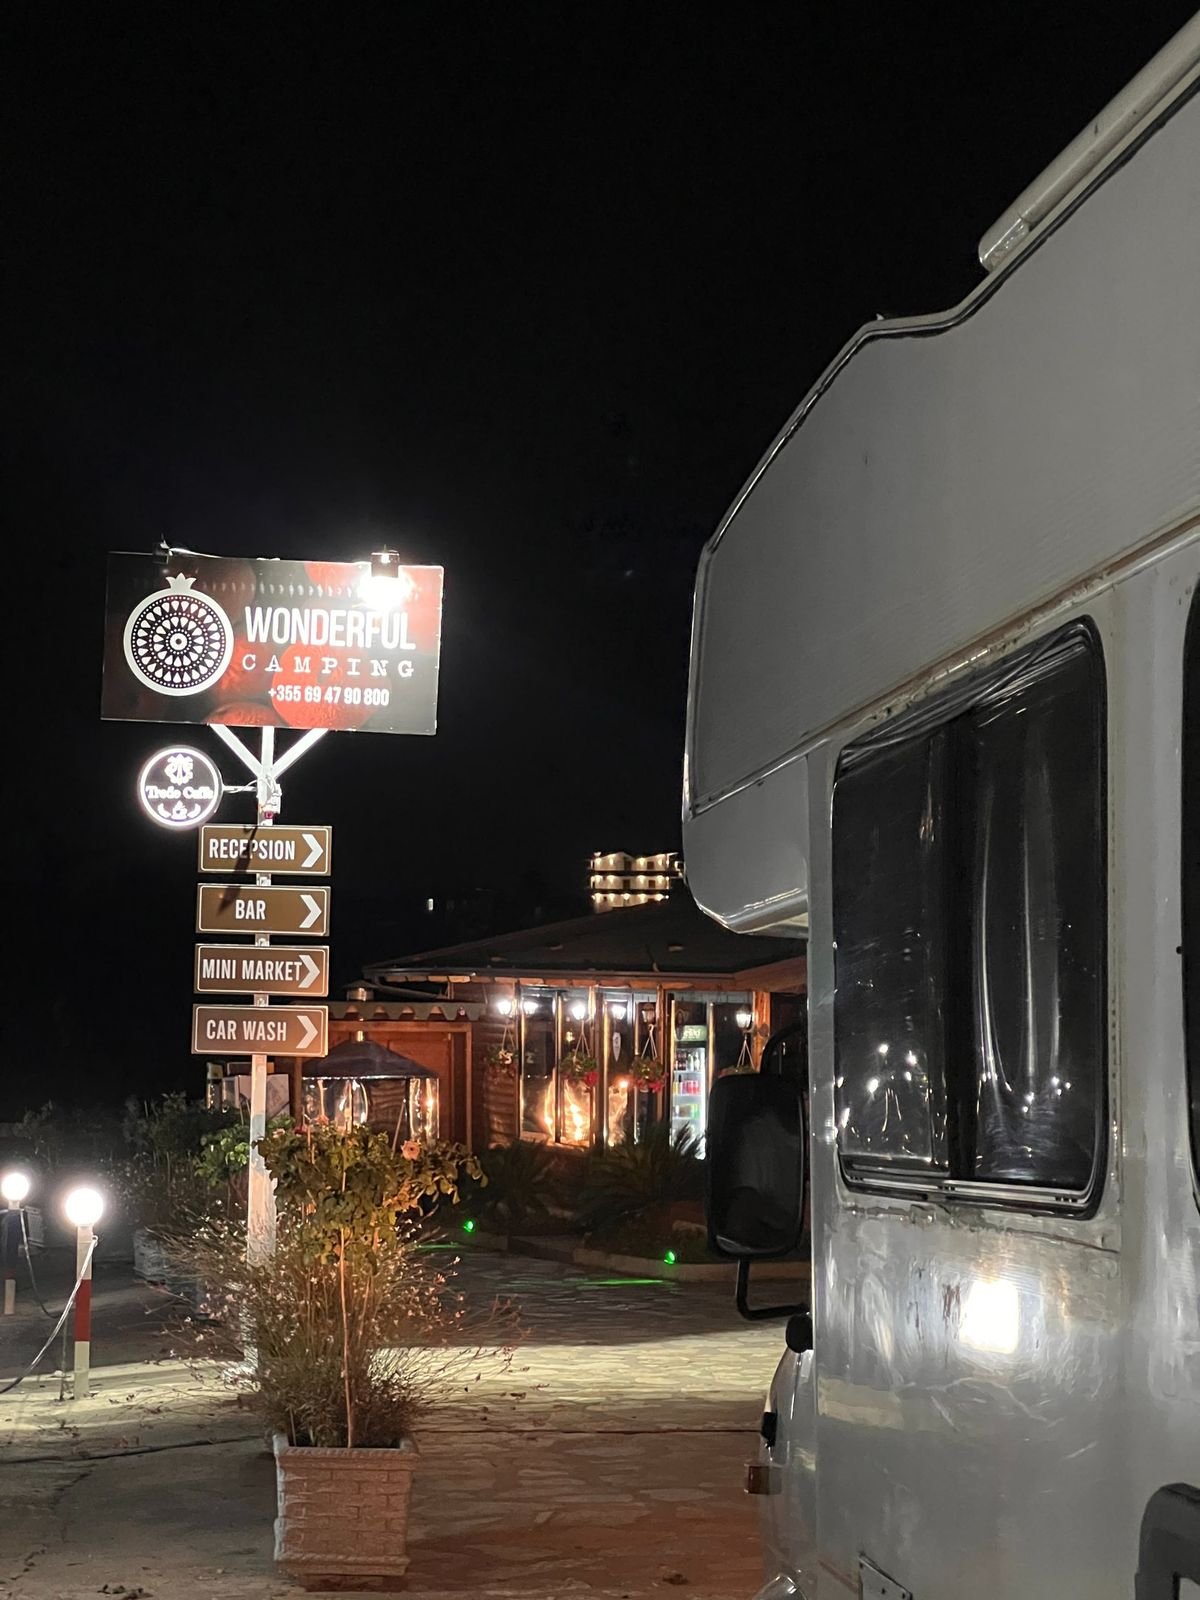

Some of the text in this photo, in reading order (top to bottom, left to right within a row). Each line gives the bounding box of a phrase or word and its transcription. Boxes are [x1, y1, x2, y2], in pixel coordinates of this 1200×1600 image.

[245, 606, 416, 649] WONDERFUL
[242, 654, 415, 678] CAMPING
[268, 684, 390, 706] +355 69 47 90 800
[209, 838, 296, 860] RECEPSION
[235, 899, 266, 920] BAR
[202, 958, 303, 981] MINI MARKET
[206, 1019, 287, 1042] CAR WASH
